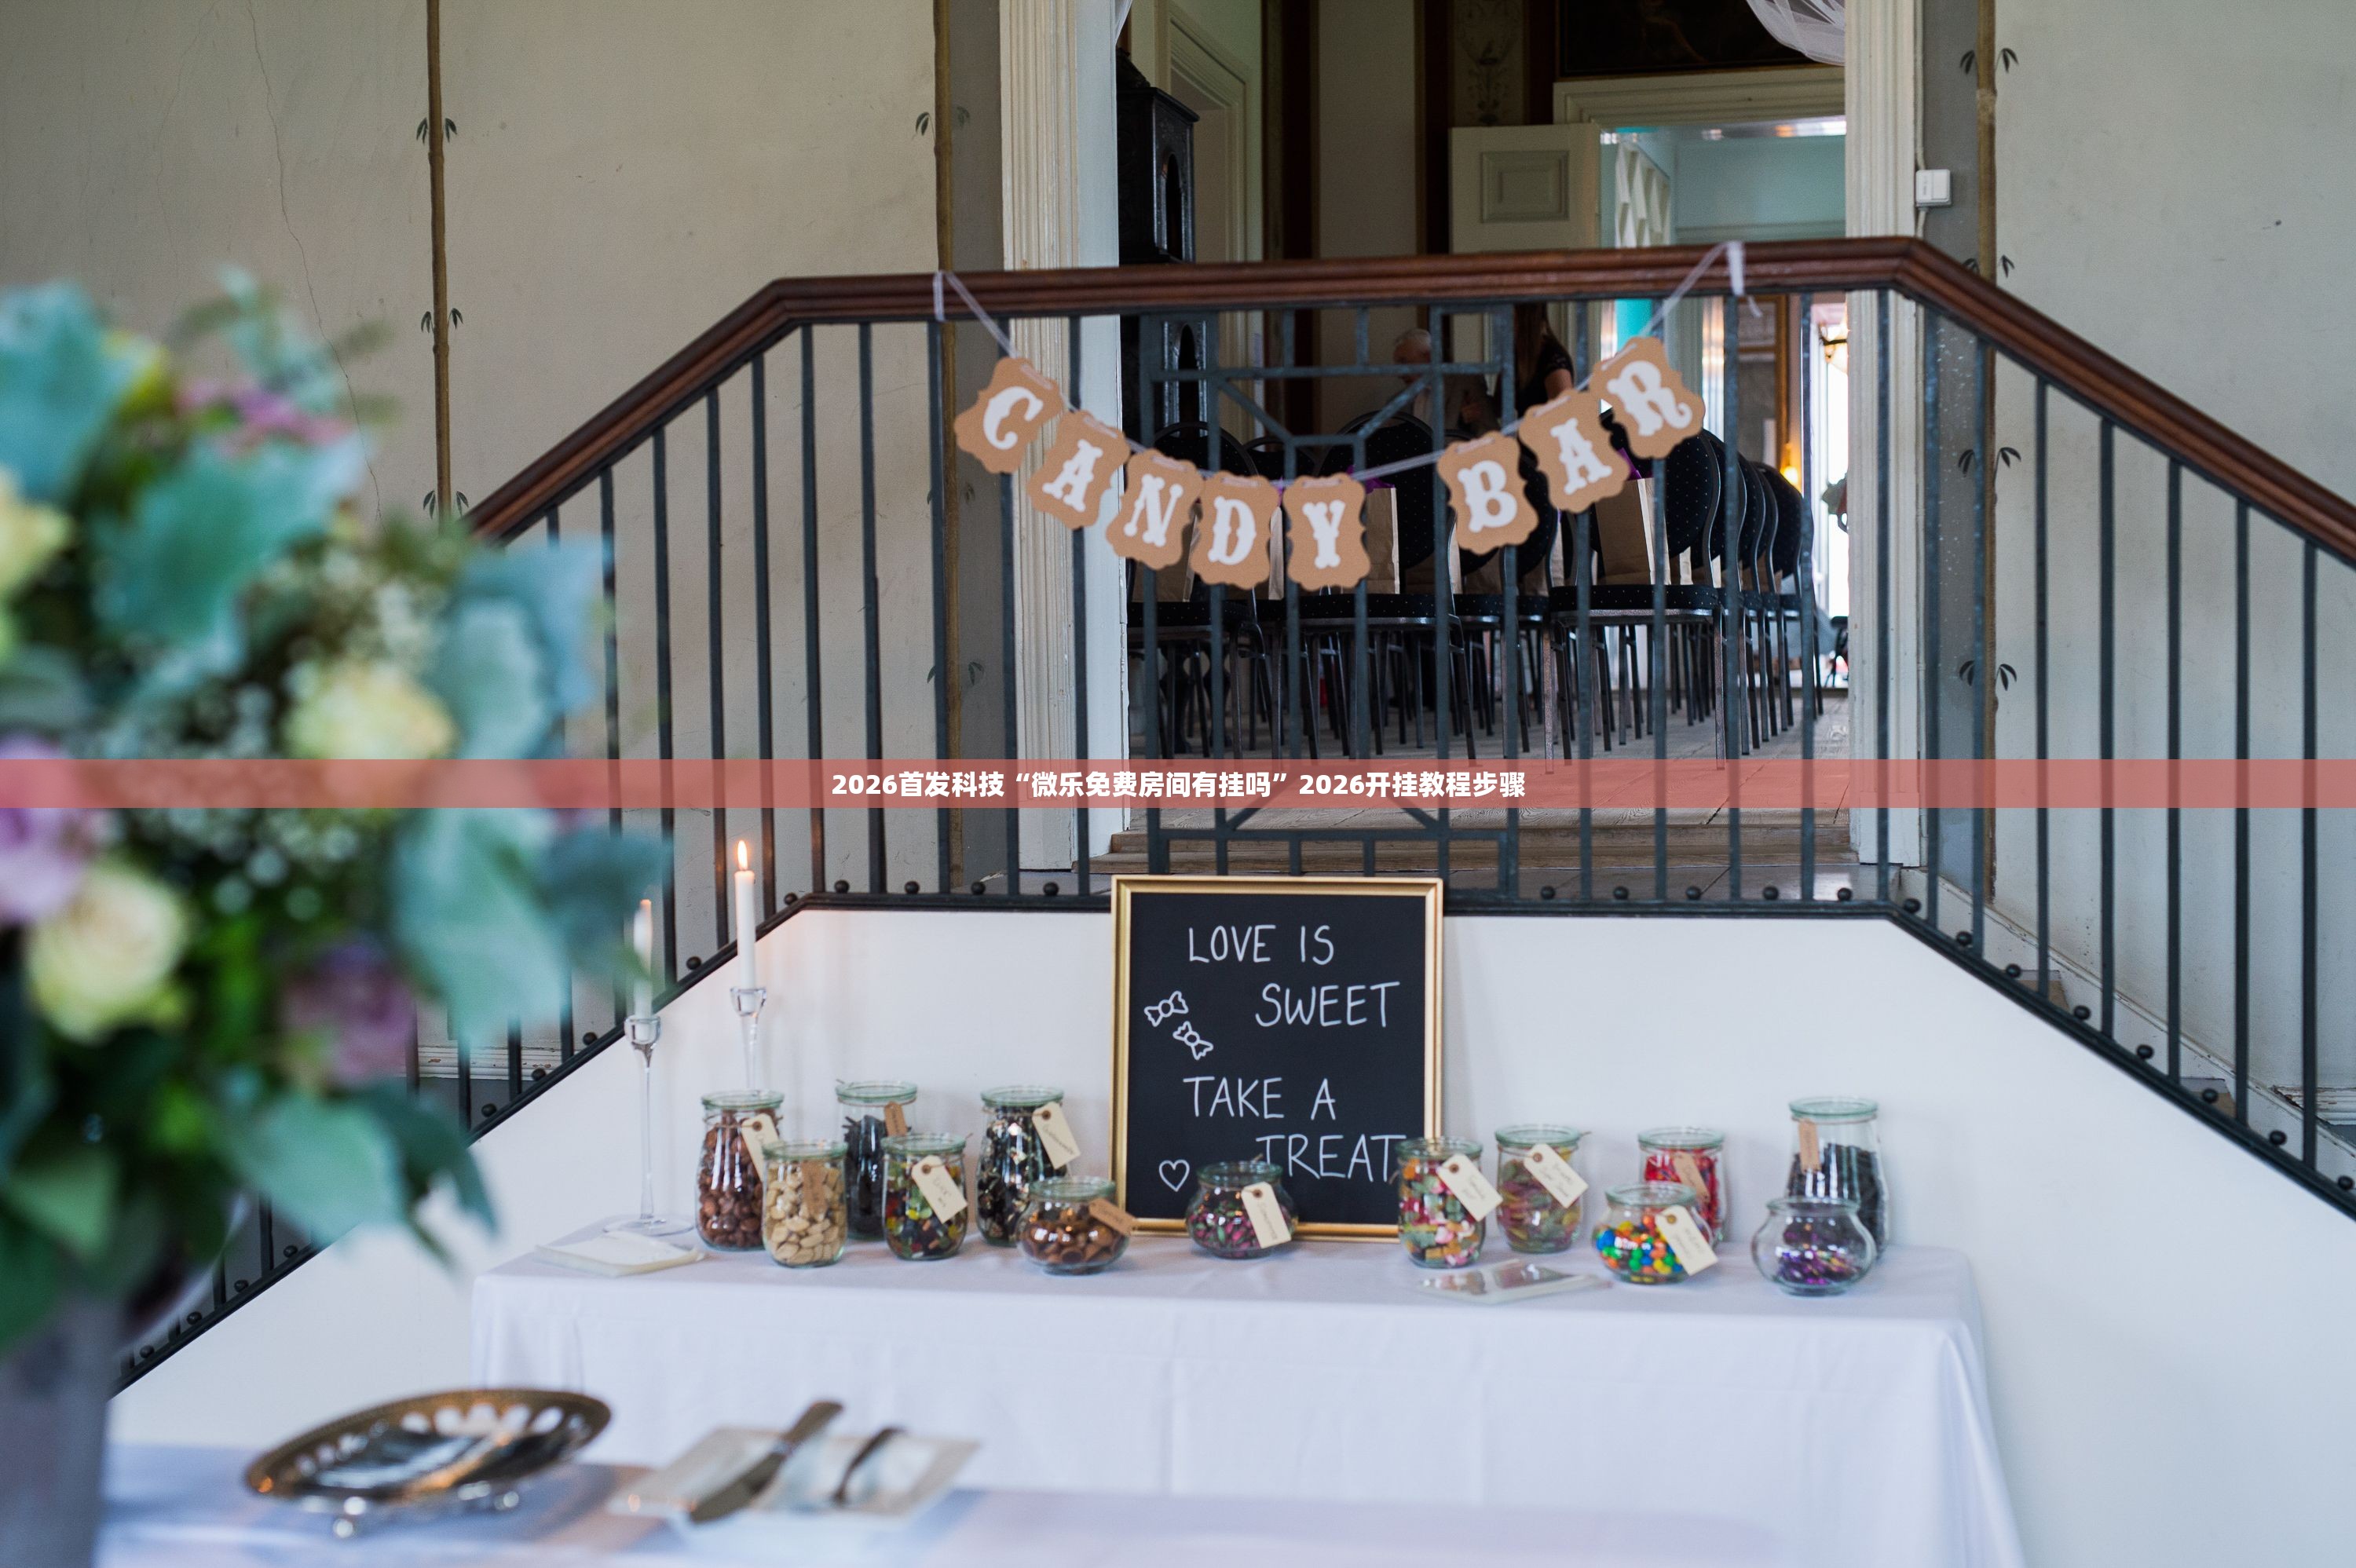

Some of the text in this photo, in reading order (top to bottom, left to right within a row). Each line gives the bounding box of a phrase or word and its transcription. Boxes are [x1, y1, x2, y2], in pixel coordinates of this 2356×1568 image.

[983, 360, 1692, 569] CANDY BAR
[1188, 924, 1334, 965] LOVE IS
[1255, 981, 1400, 1028] SWEET
[1183, 1076, 1336, 1120] TAKE A
[1256, 1134, 1407, 1182] TREAT
